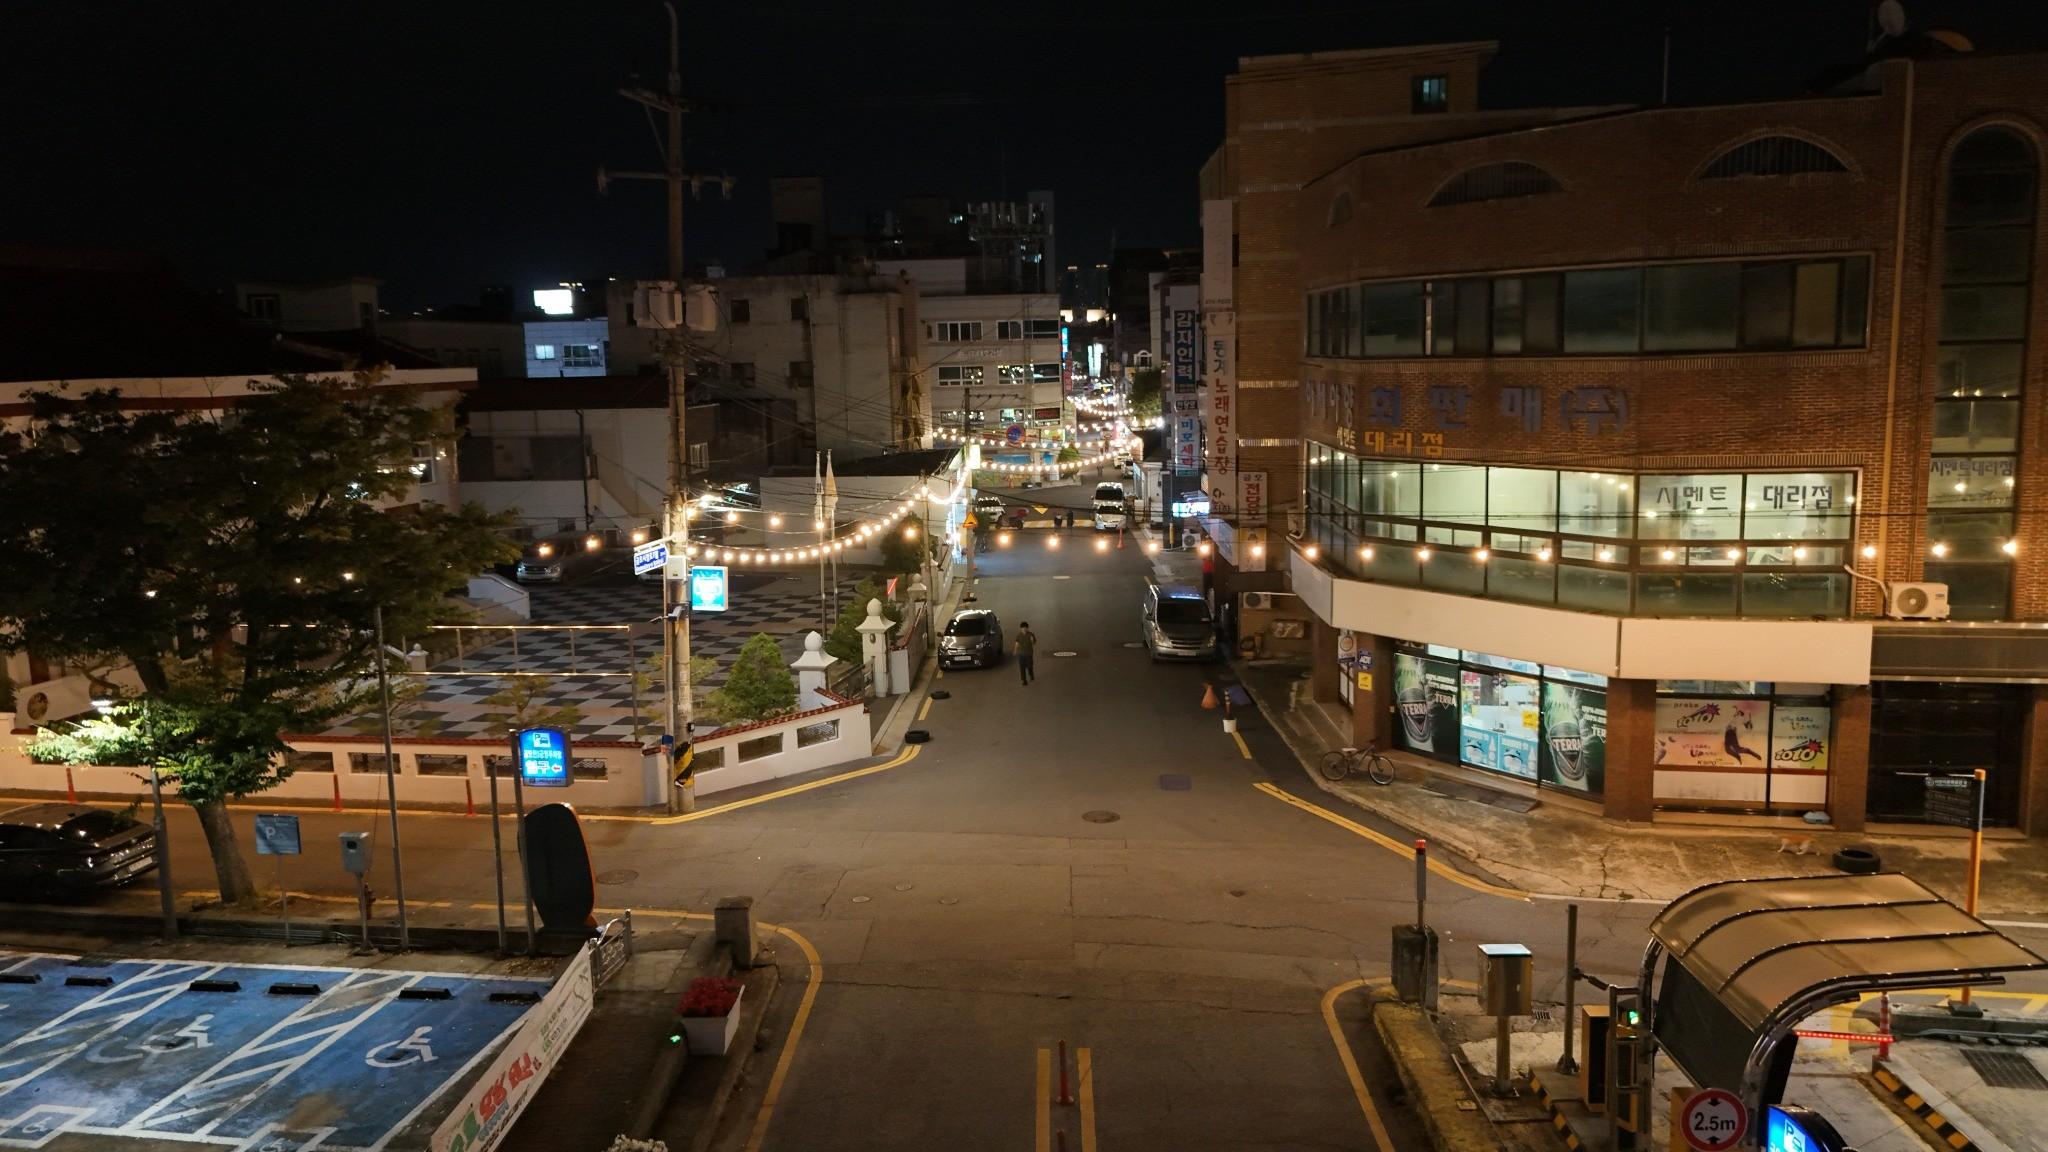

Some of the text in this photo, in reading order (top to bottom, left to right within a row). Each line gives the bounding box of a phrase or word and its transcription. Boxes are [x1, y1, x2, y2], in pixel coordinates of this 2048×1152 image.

[1363, 431, 1444, 457] 대리점
[1656, 485, 1832, 511] 시멘트 대리점
[1434, 692, 1457, 707] TERRA
[1402, 702, 1427, 715] TERRA
[1553, 737, 1583, 752] TERRA
[1694, 1112, 1736, 1131] 2.5m
